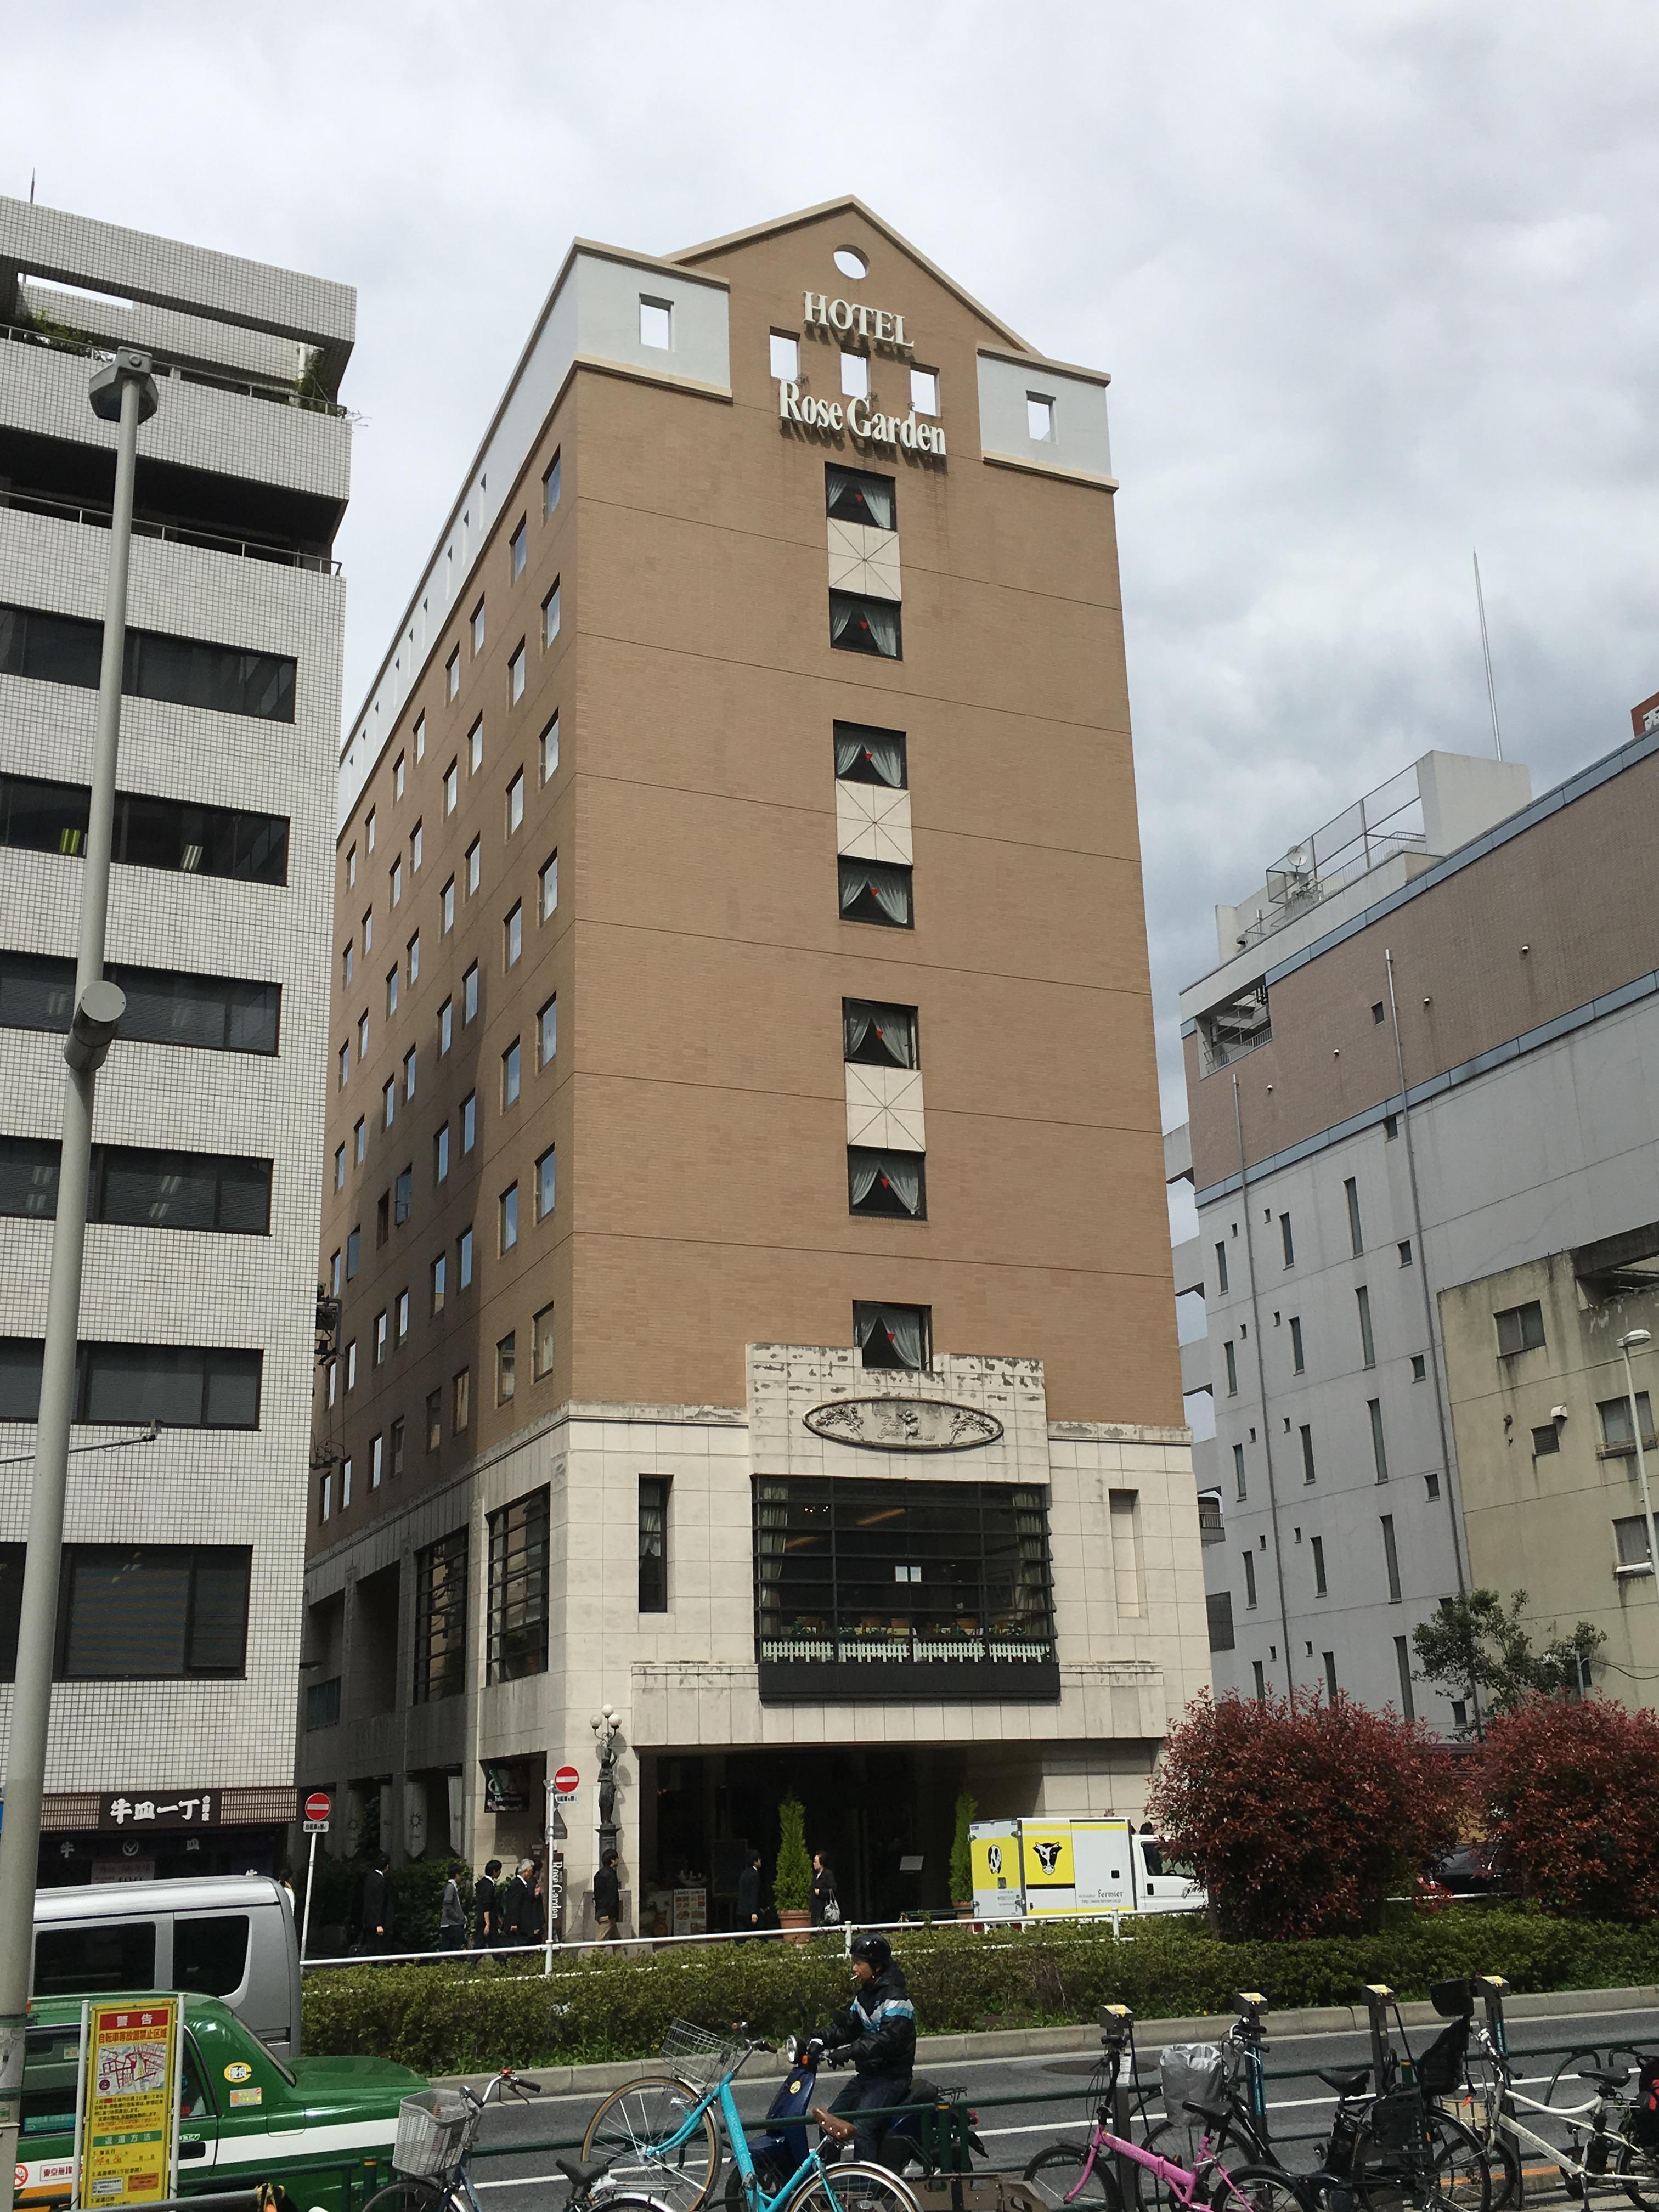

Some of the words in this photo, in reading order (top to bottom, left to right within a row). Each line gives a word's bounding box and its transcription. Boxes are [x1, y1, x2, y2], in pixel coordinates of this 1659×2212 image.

[802, 291, 915, 349] HOTEL
[778, 379, 843, 431] Rose
[847, 397, 947, 456] Garden
[552, 1884, 563, 1919] Garden
[1098, 1889, 1123, 1898] fermier
